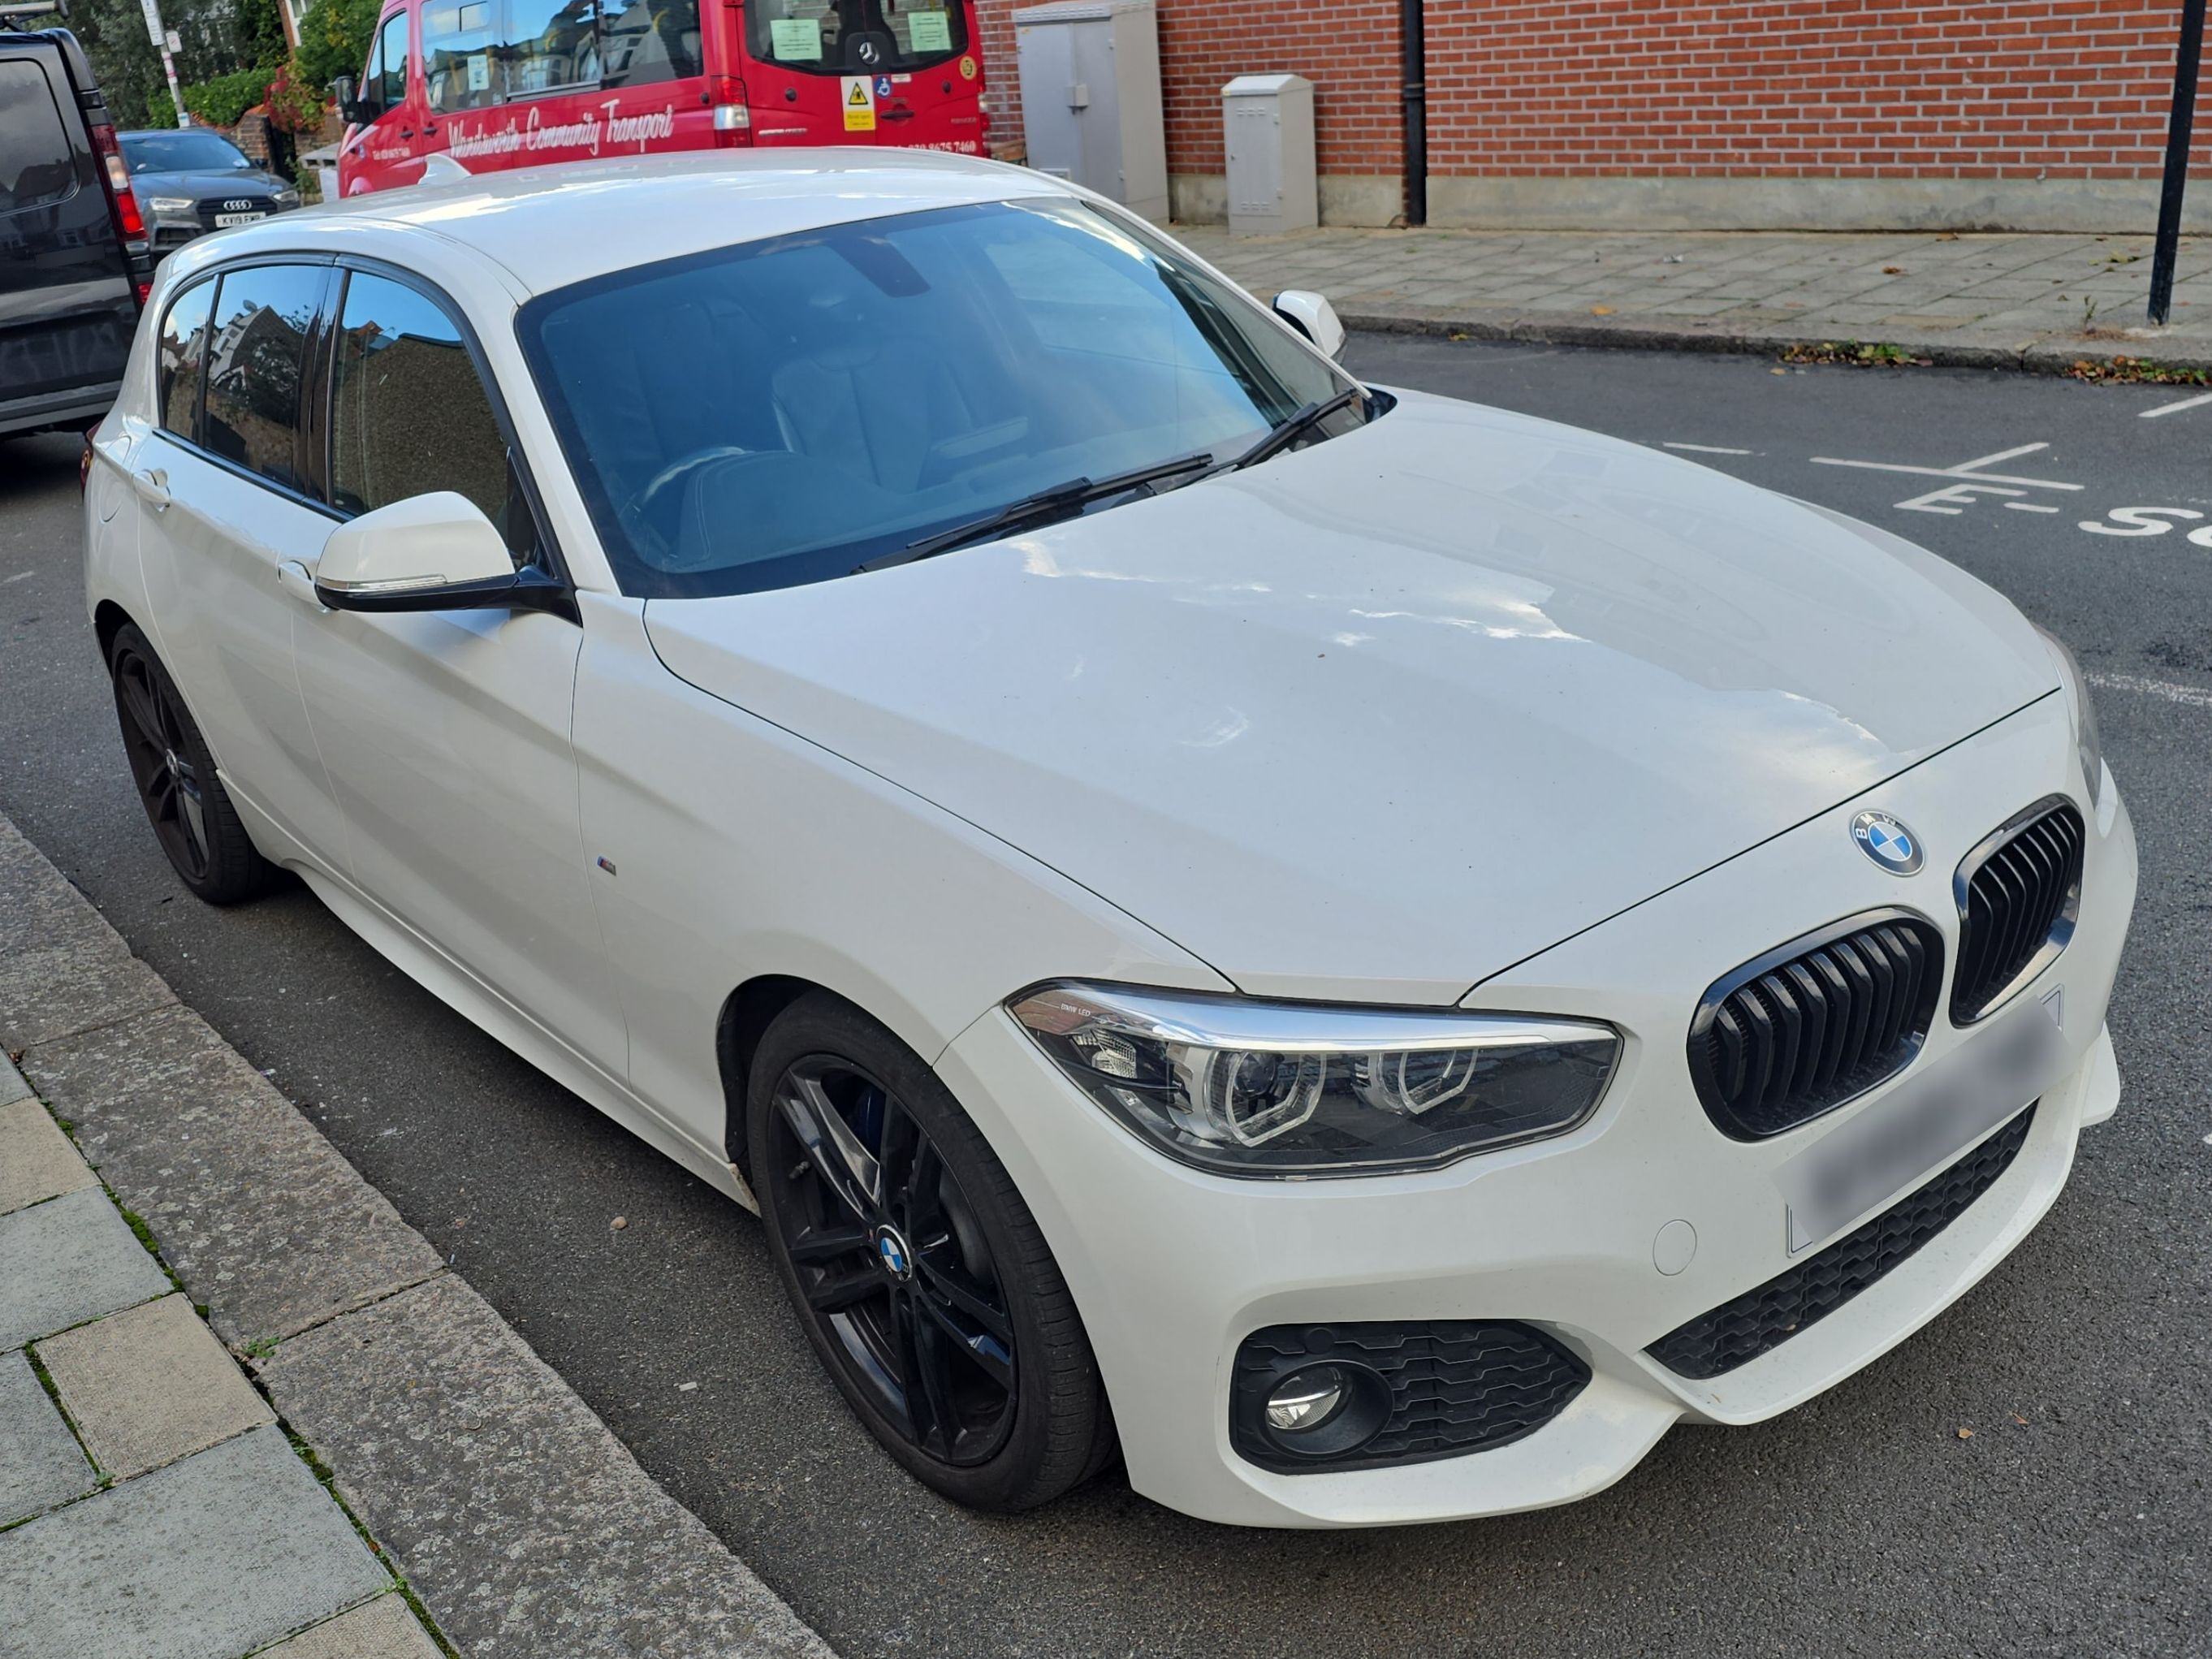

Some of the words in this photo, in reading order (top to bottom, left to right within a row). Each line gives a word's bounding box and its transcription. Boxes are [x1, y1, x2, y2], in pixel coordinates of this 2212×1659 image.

[448, 117, 521, 158] Wandsworth
[526, 106, 602, 156] Community
[600, 98, 675, 153] Transport
[1855, 813, 1899, 840] BMW
[1078, 1008, 1091, 1017] LED
